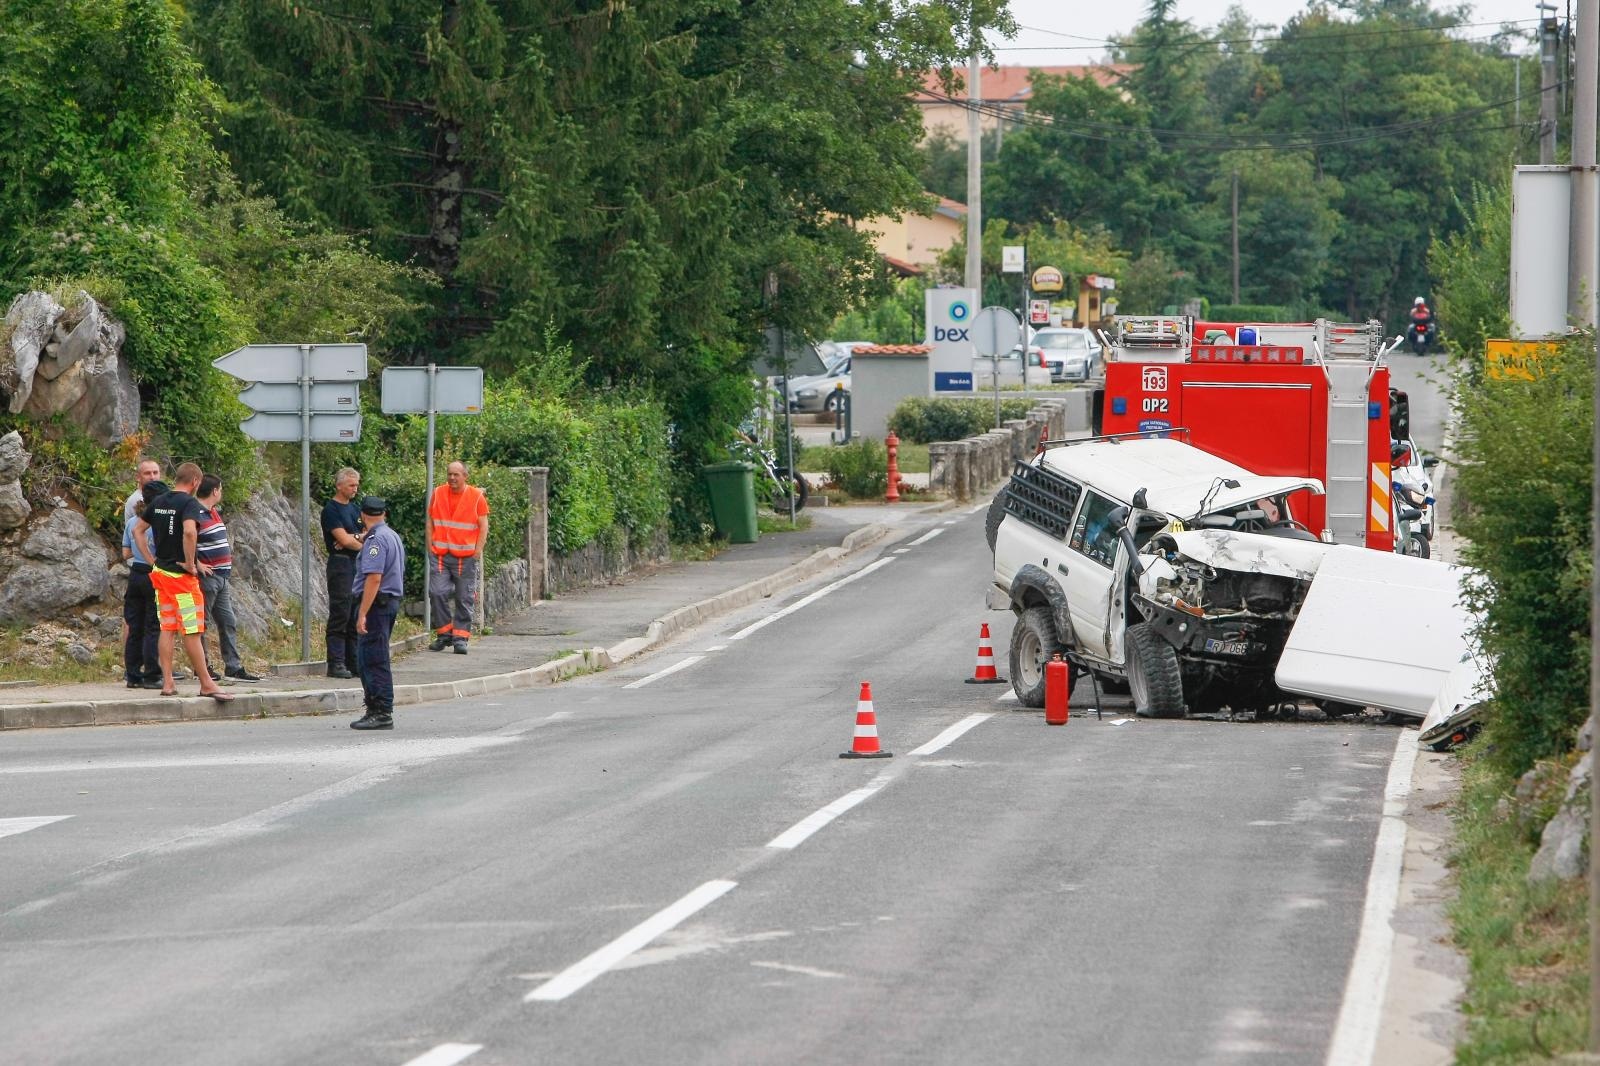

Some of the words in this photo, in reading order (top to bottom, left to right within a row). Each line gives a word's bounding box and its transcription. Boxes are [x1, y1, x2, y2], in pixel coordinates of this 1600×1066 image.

[934, 325, 969, 342] bex
[1143, 376, 1166, 389] 193
[1142, 397, 1168, 412] OP2
